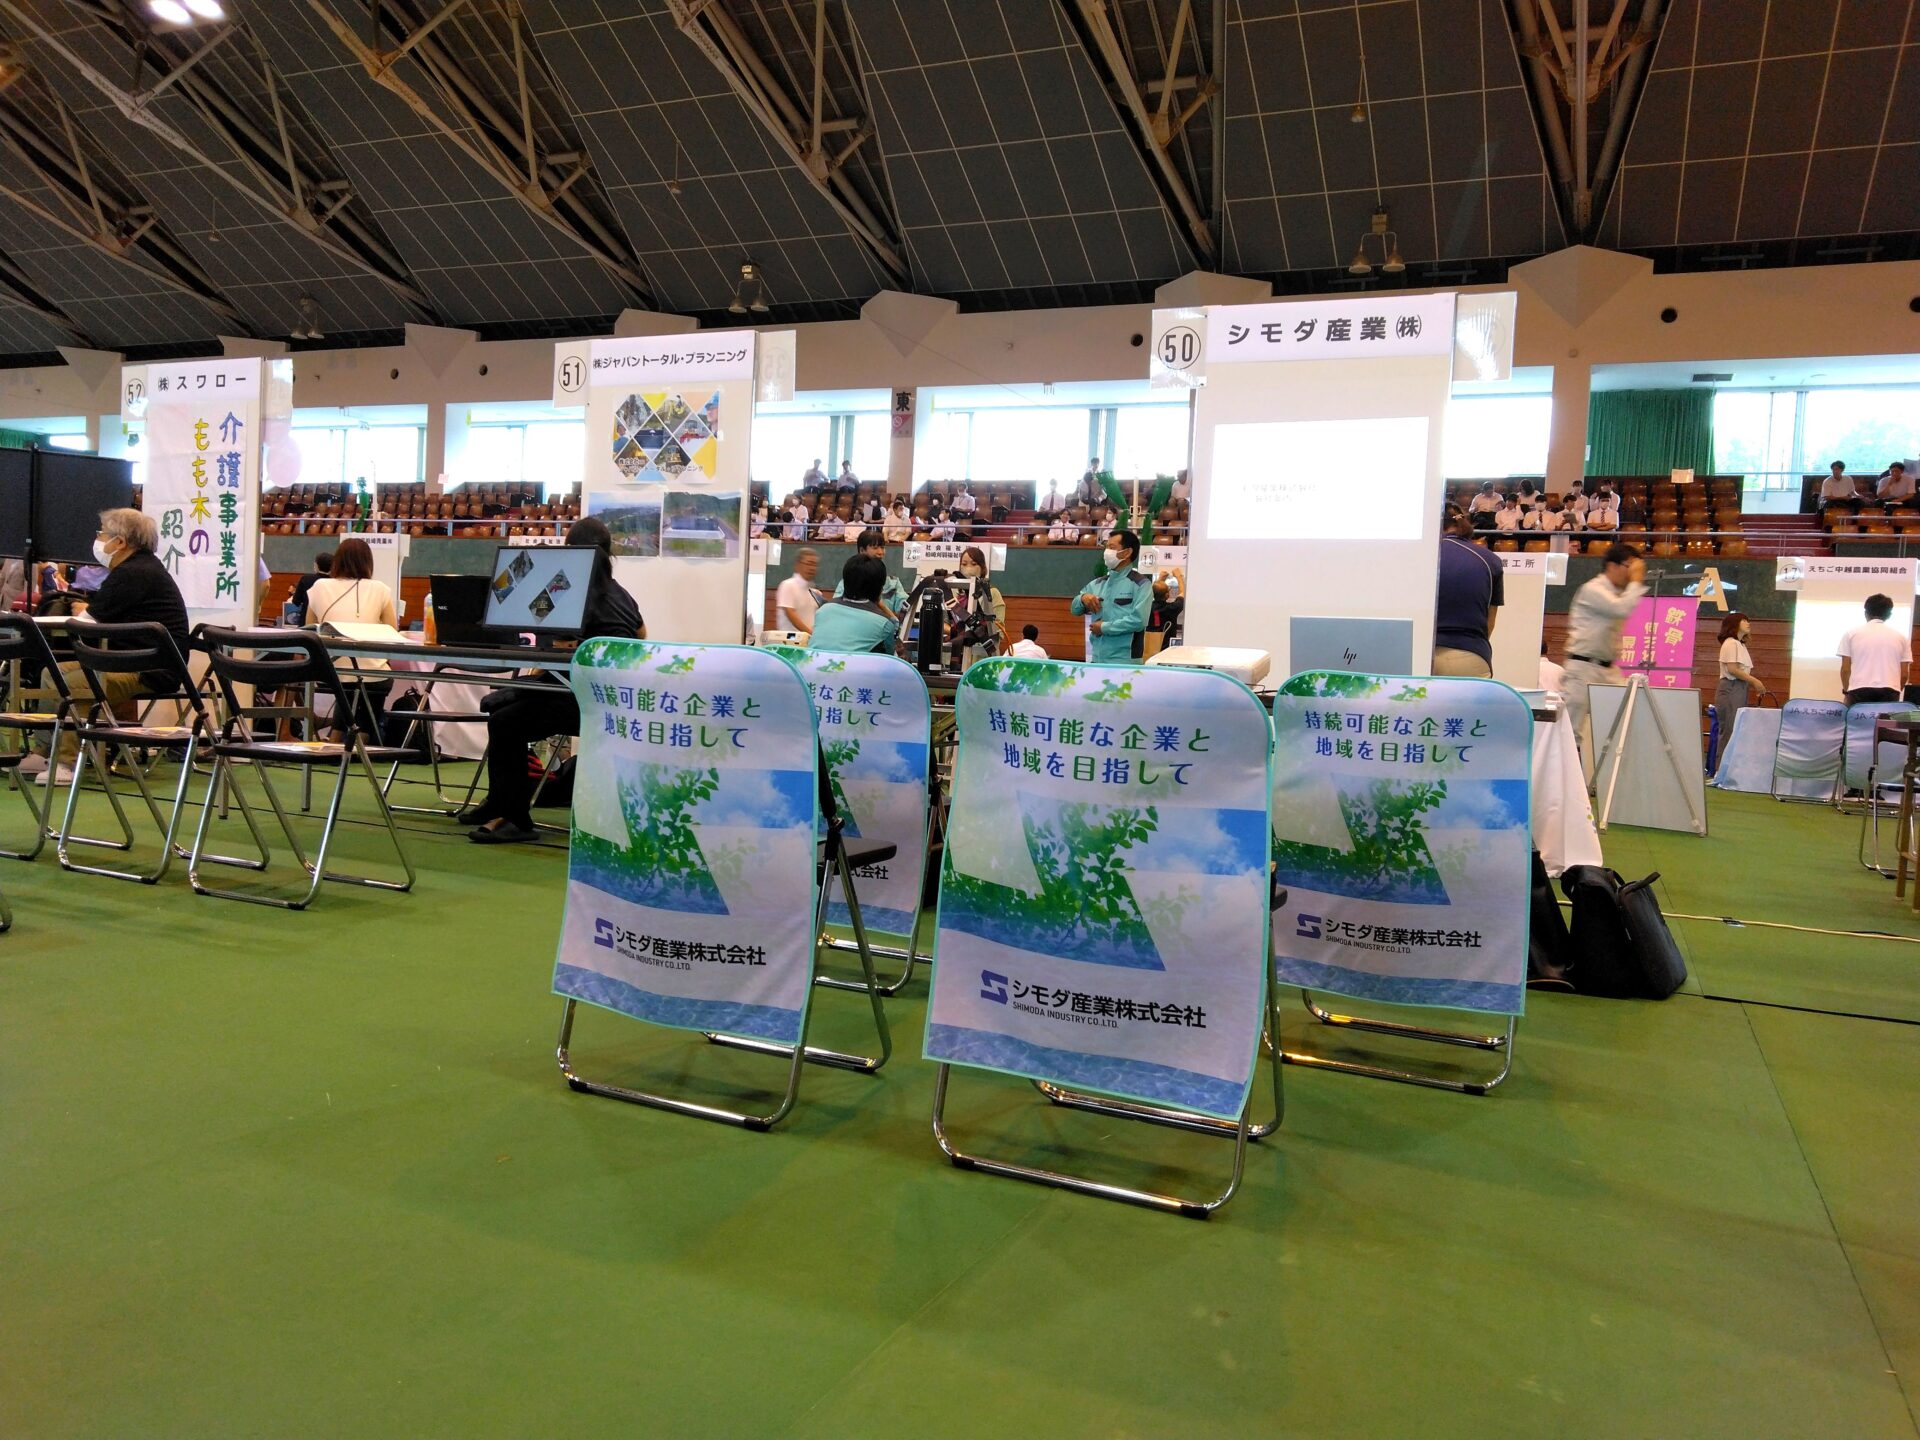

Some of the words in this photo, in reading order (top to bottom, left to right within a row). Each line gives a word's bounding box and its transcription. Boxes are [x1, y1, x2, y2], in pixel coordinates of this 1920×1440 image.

[1165, 334, 1193, 362] 50
[562, 362, 580, 386] 51
[128, 384, 142, 404] 52
[896, 391, 911, 412] 東
[189, 418, 211, 555] もも木の
[216, 411, 243, 603] 介護事業所
[161, 509, 185, 575] 紹介
[590, 682, 761, 719] 持続可能な企業と
[604, 712, 749, 749] 地域を目指して
[988, 708, 1210, 752] 持続可能な企業と
[1305, 711, 1488, 738] 持続可能な企業と
[1003, 742, 1193, 785] 地域を目指して
[1315, 736, 1474, 763] 地域を目指して
[615, 926, 767, 966] シモダ産業株式会社
[1326, 919, 1482, 948] シモダ産業株式会社
[1326, 935, 1352, 946] SHIMODA
[1353, 941, 1385, 952] INDUSTRY
[636, 954, 664, 968] INDUSTRY
[1012, 980, 1206, 1028] シモダ産業株式会社
[1013, 1001, 1045, 1016] SHIMODA
[1047, 1010, 1086, 1024] INDUSTRY
